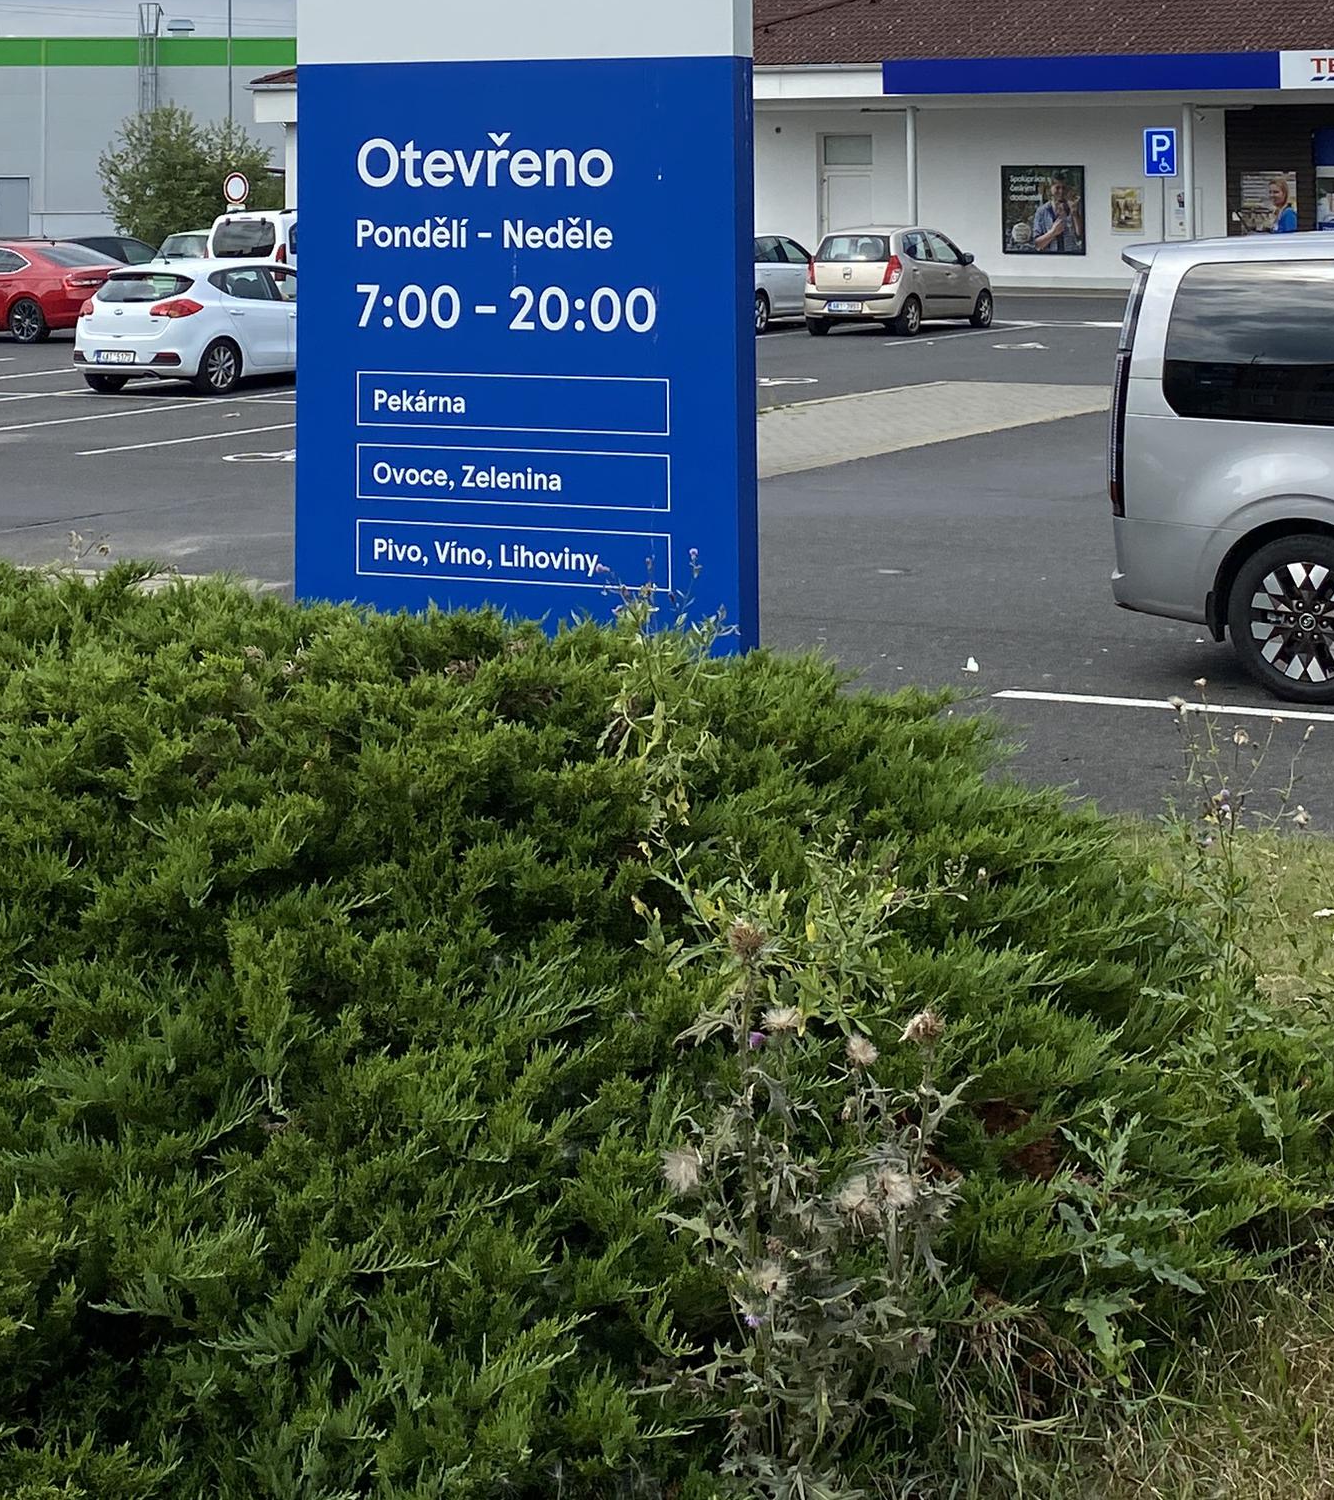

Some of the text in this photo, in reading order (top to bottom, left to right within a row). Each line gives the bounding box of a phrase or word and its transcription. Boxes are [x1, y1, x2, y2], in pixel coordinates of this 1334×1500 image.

[356, 132, 614, 189] Otevřeno
[1151, 134, 1171, 162] P
[355, 216, 467, 249] Pondělí
[502, 217, 613, 251] Neděle
[355, 283, 461, 329] 7:00
[509, 285, 657, 333] 20:00
[373, 388, 467, 415] Pekárna
[372, 461, 563, 492] Ovoce, Zelenina
[373, 537, 599, 577] Pivo, Víno, Lihoviny
